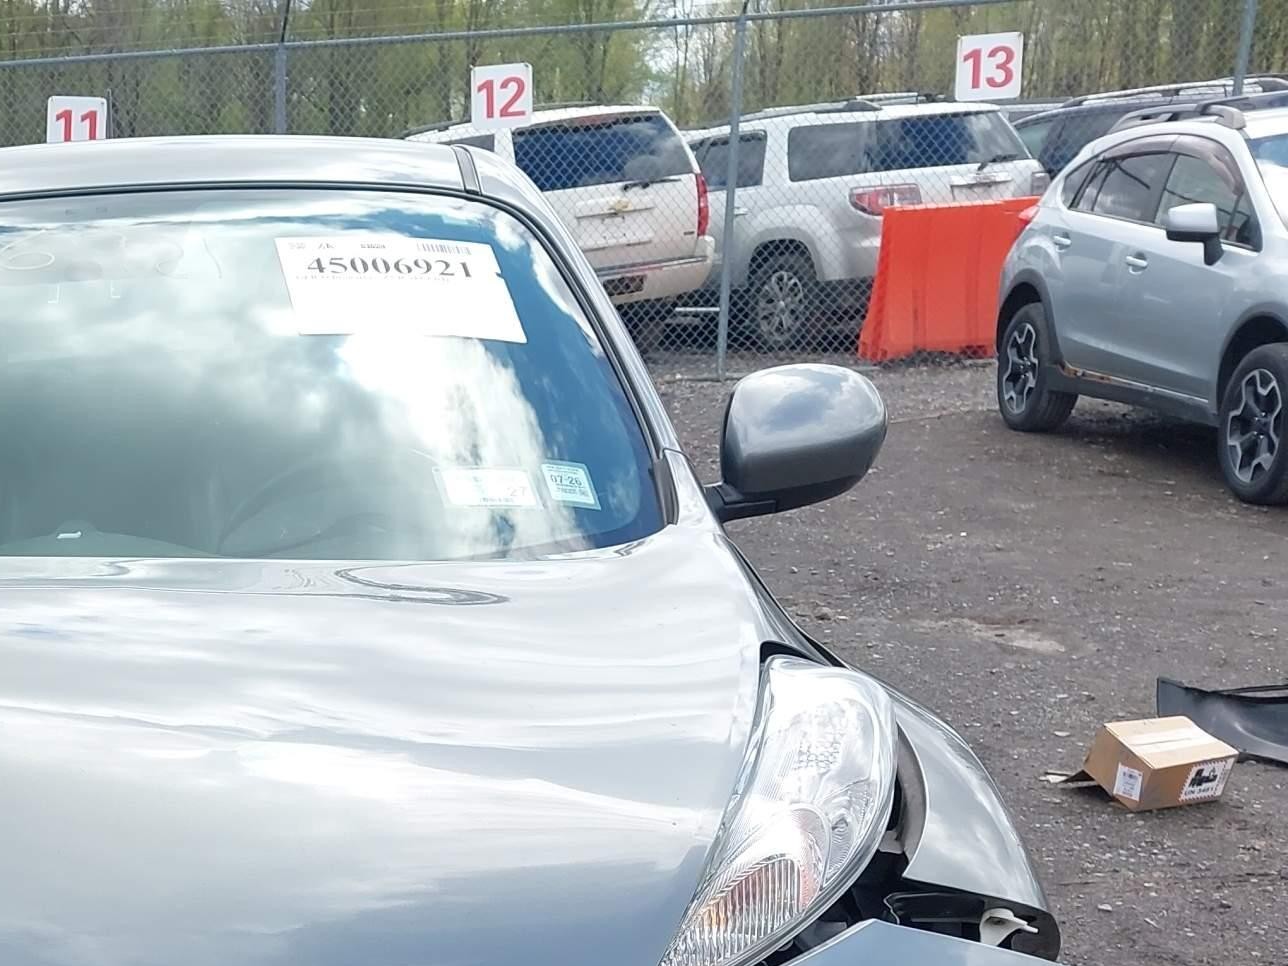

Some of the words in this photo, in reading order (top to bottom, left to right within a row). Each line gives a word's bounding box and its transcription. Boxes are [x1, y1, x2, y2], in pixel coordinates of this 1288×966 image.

[962, 46, 1015, 89] 13
[476, 77, 526, 118] 12
[55, 109, 97, 142] 11
[307, 257, 472, 277] 45006921
